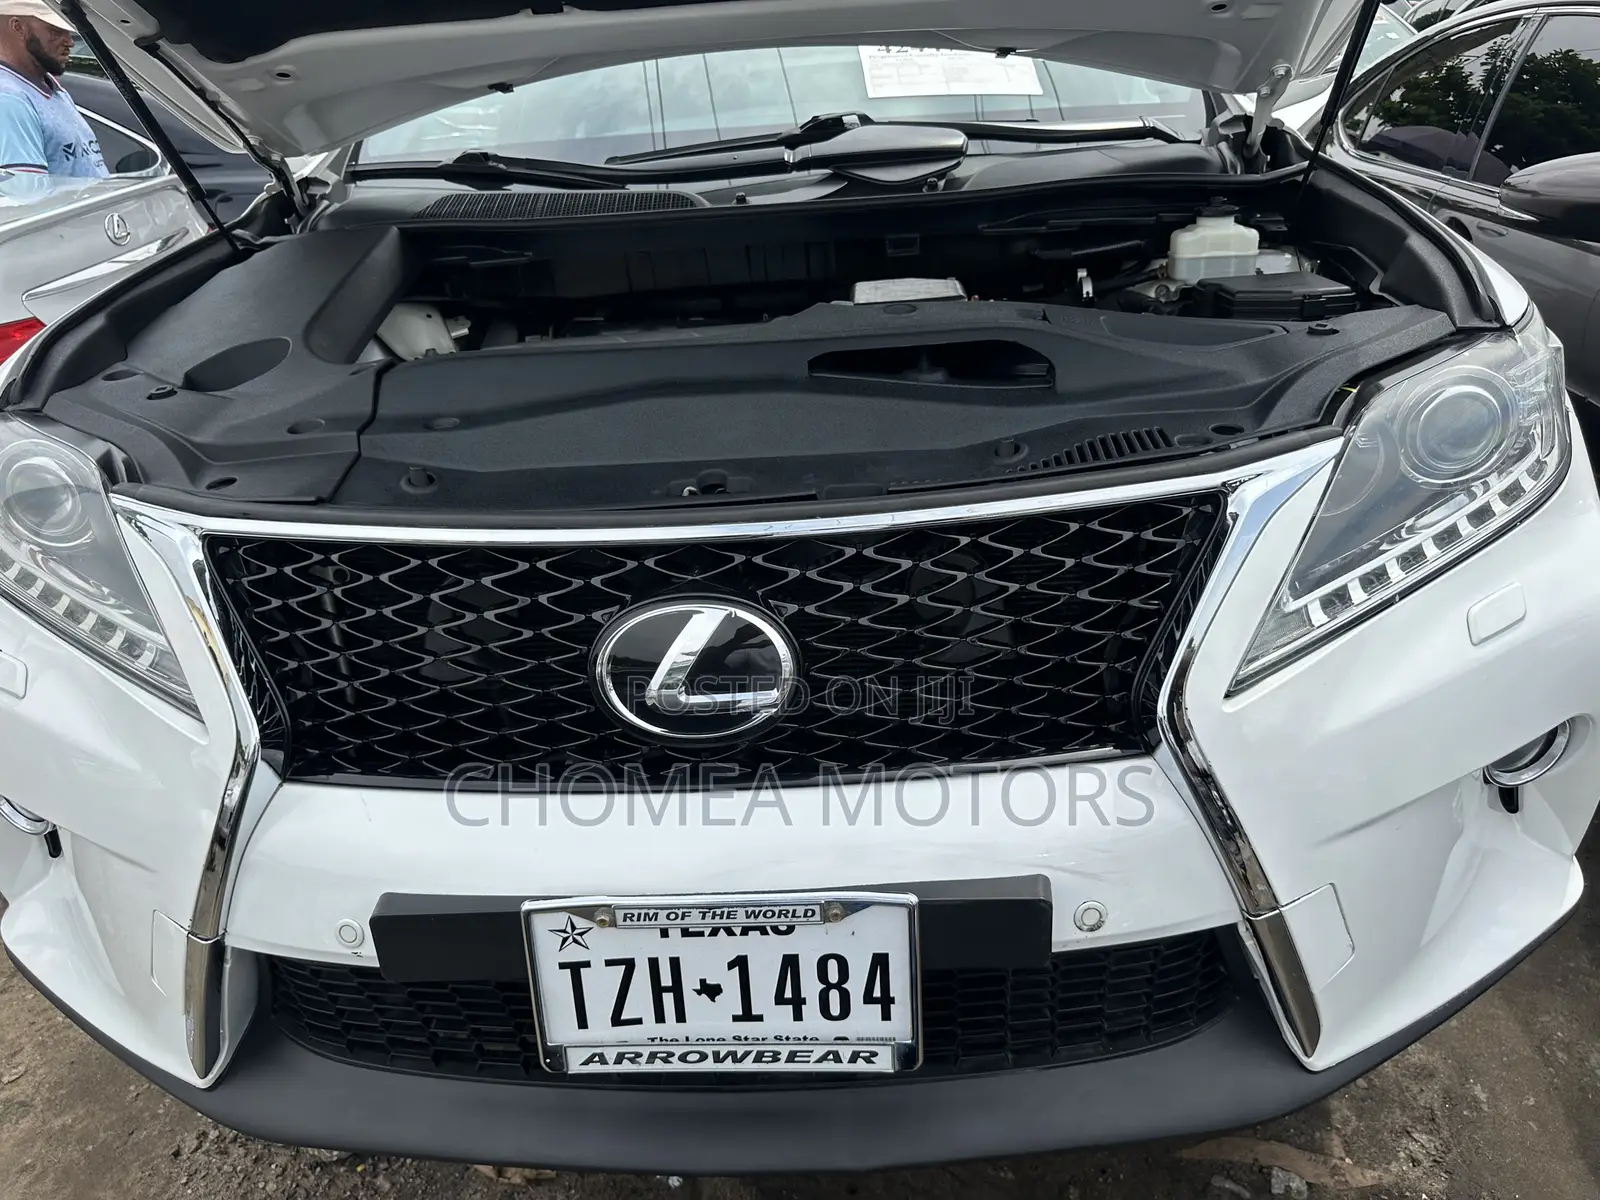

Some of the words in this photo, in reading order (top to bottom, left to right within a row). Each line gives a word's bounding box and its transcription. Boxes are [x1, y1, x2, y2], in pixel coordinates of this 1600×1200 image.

[622, 911, 659, 922] RIM
[665, 910, 692, 921] OF
[699, 909, 738, 921] THE
[744, 908, 817, 920] WORLD
[558, 955, 688, 1031] TZH
[726, 951, 896, 1024] 1484
[578, 1049, 880, 1067] ARROWBEAR
